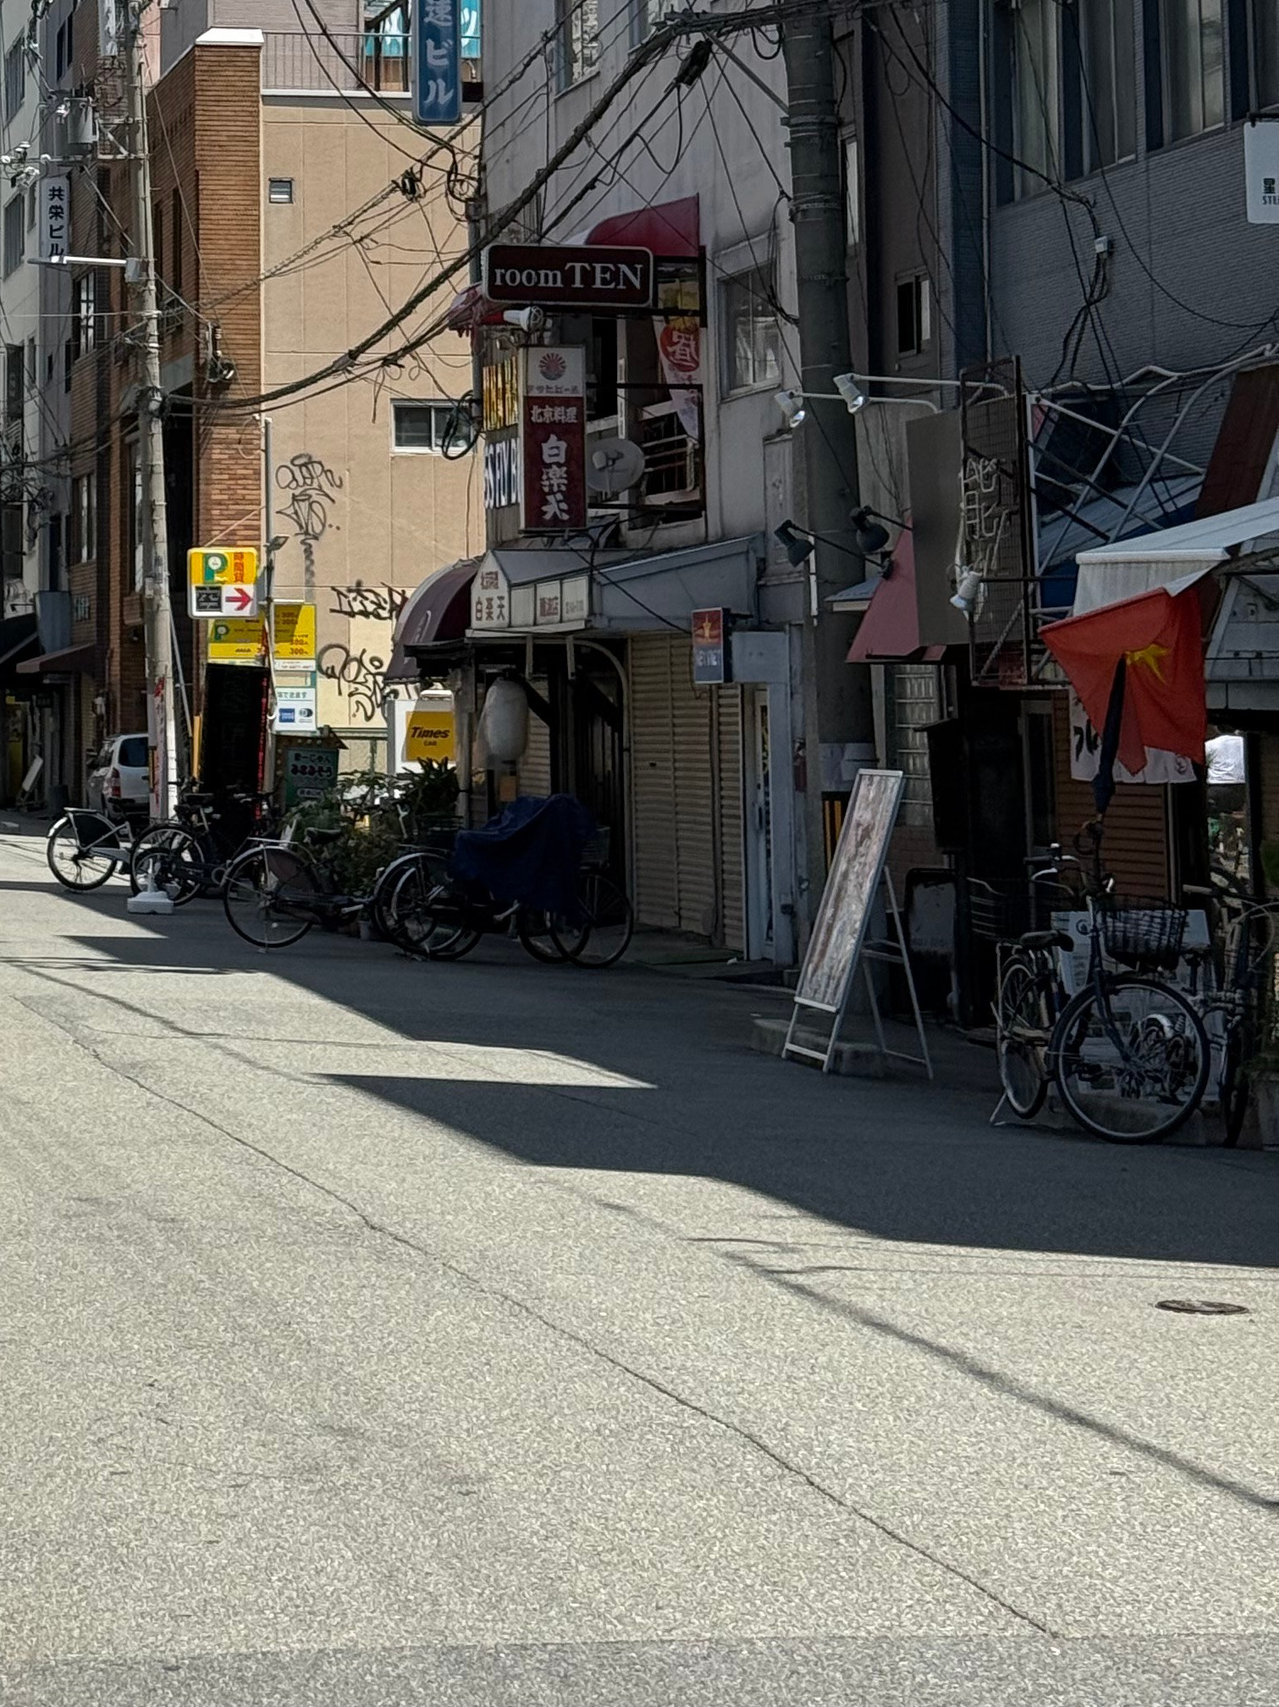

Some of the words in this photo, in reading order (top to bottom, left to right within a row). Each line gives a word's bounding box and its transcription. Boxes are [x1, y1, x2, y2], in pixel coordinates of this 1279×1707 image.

[48, 185, 65, 258] 共栄ビル
[530, 404, 579, 424] 北京料理
[411, 726, 450, 739] Times
